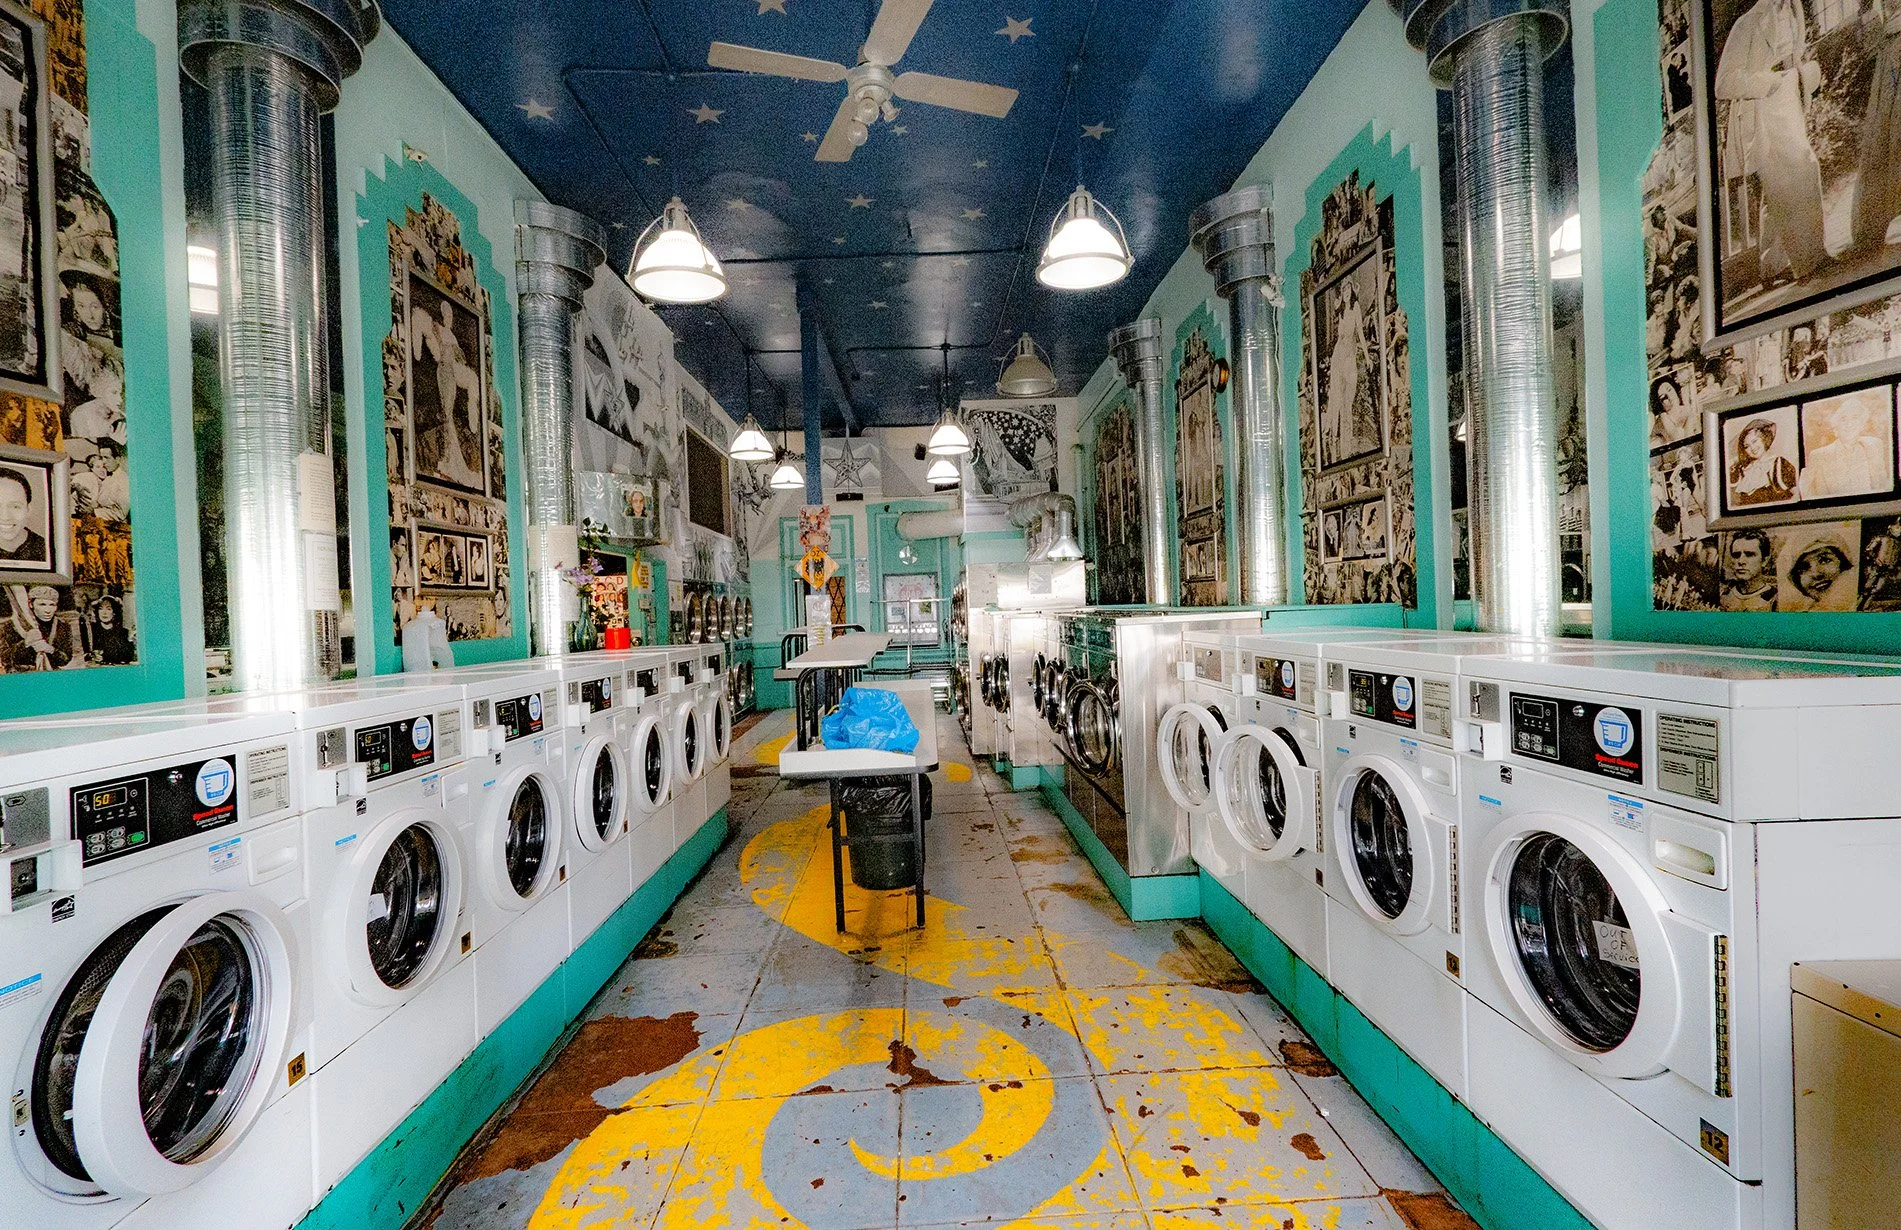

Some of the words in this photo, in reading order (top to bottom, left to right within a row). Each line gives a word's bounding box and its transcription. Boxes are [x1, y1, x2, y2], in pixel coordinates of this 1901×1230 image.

[1659, 716, 1683, 724] OPERATING
[1683, 719, 1716, 728] INSTRUCTIONS
[1683, 751, 1717, 761] INSTRUCTIONS
[1600, 925, 1627, 938] OUT
[1610, 940, 1628, 951] OF
[291, 1060, 303, 1077] 15
[1705, 1131, 1724, 1154] 12
